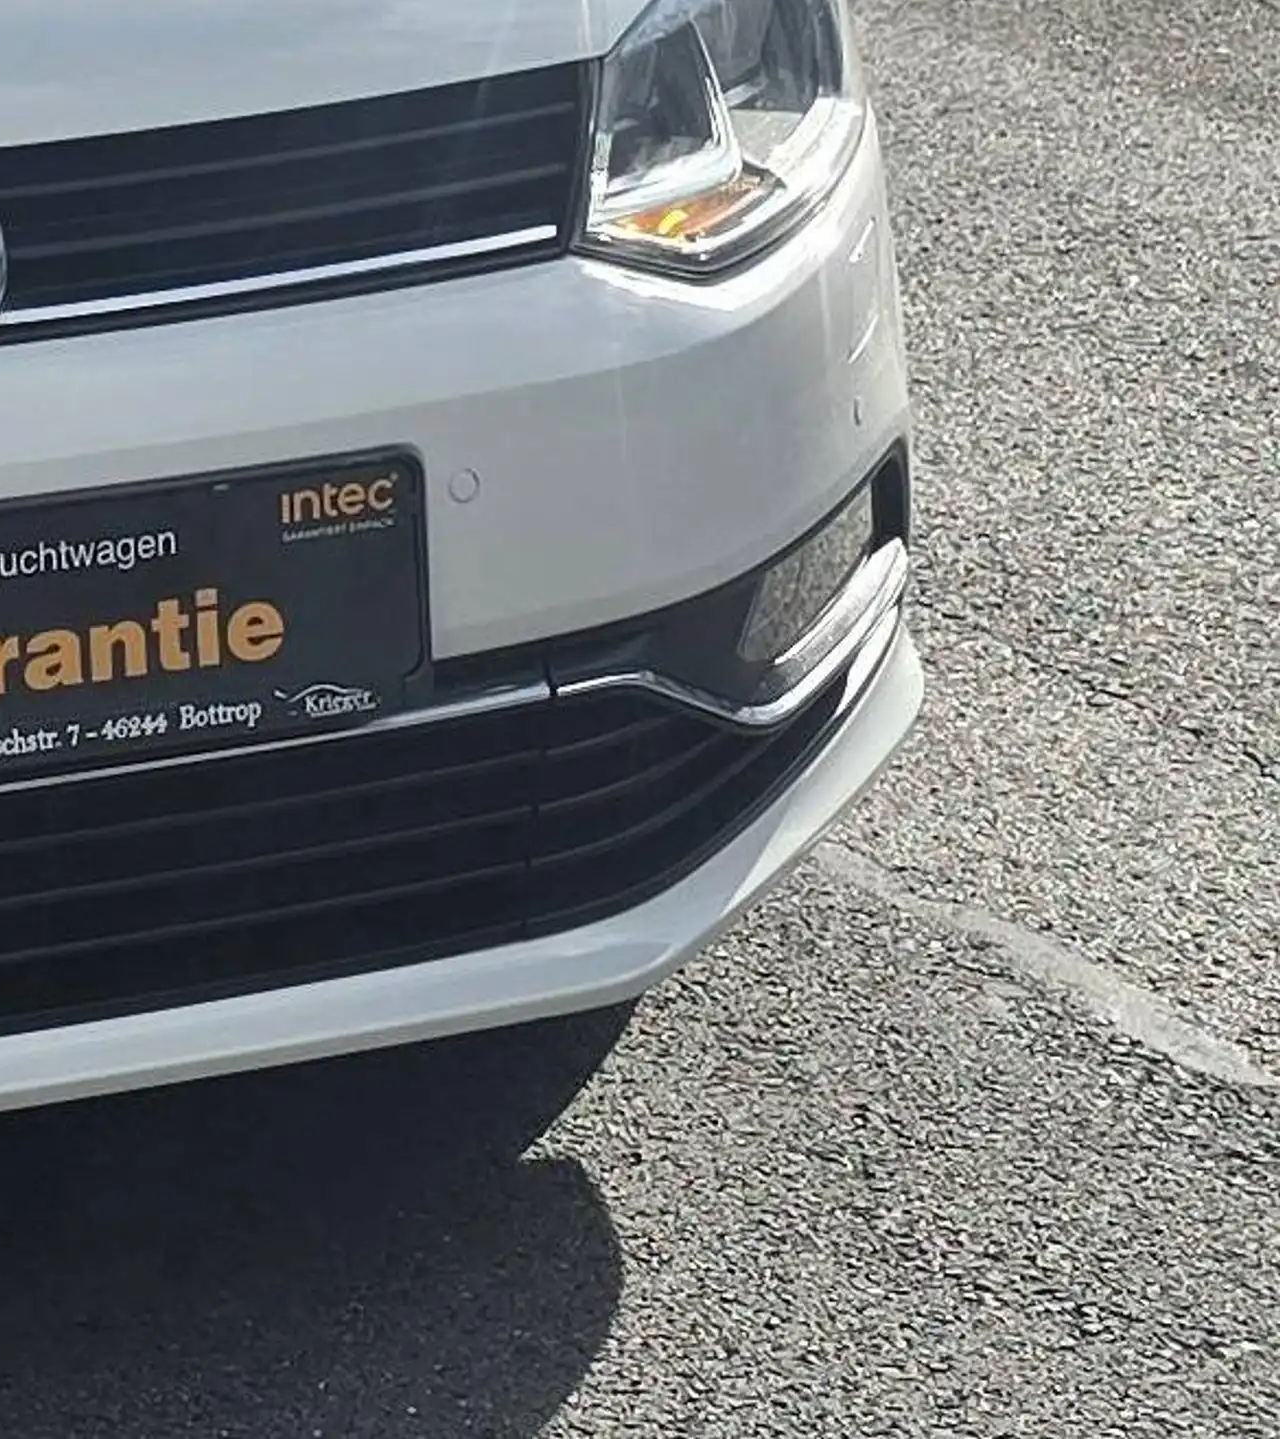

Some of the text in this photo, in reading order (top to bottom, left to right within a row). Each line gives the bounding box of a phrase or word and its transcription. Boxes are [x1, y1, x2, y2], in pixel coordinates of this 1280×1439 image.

[66, 724, 80, 747] 7
[101, 712, 168, 741] 46244
[179, 702, 262, 730] Bottrop
